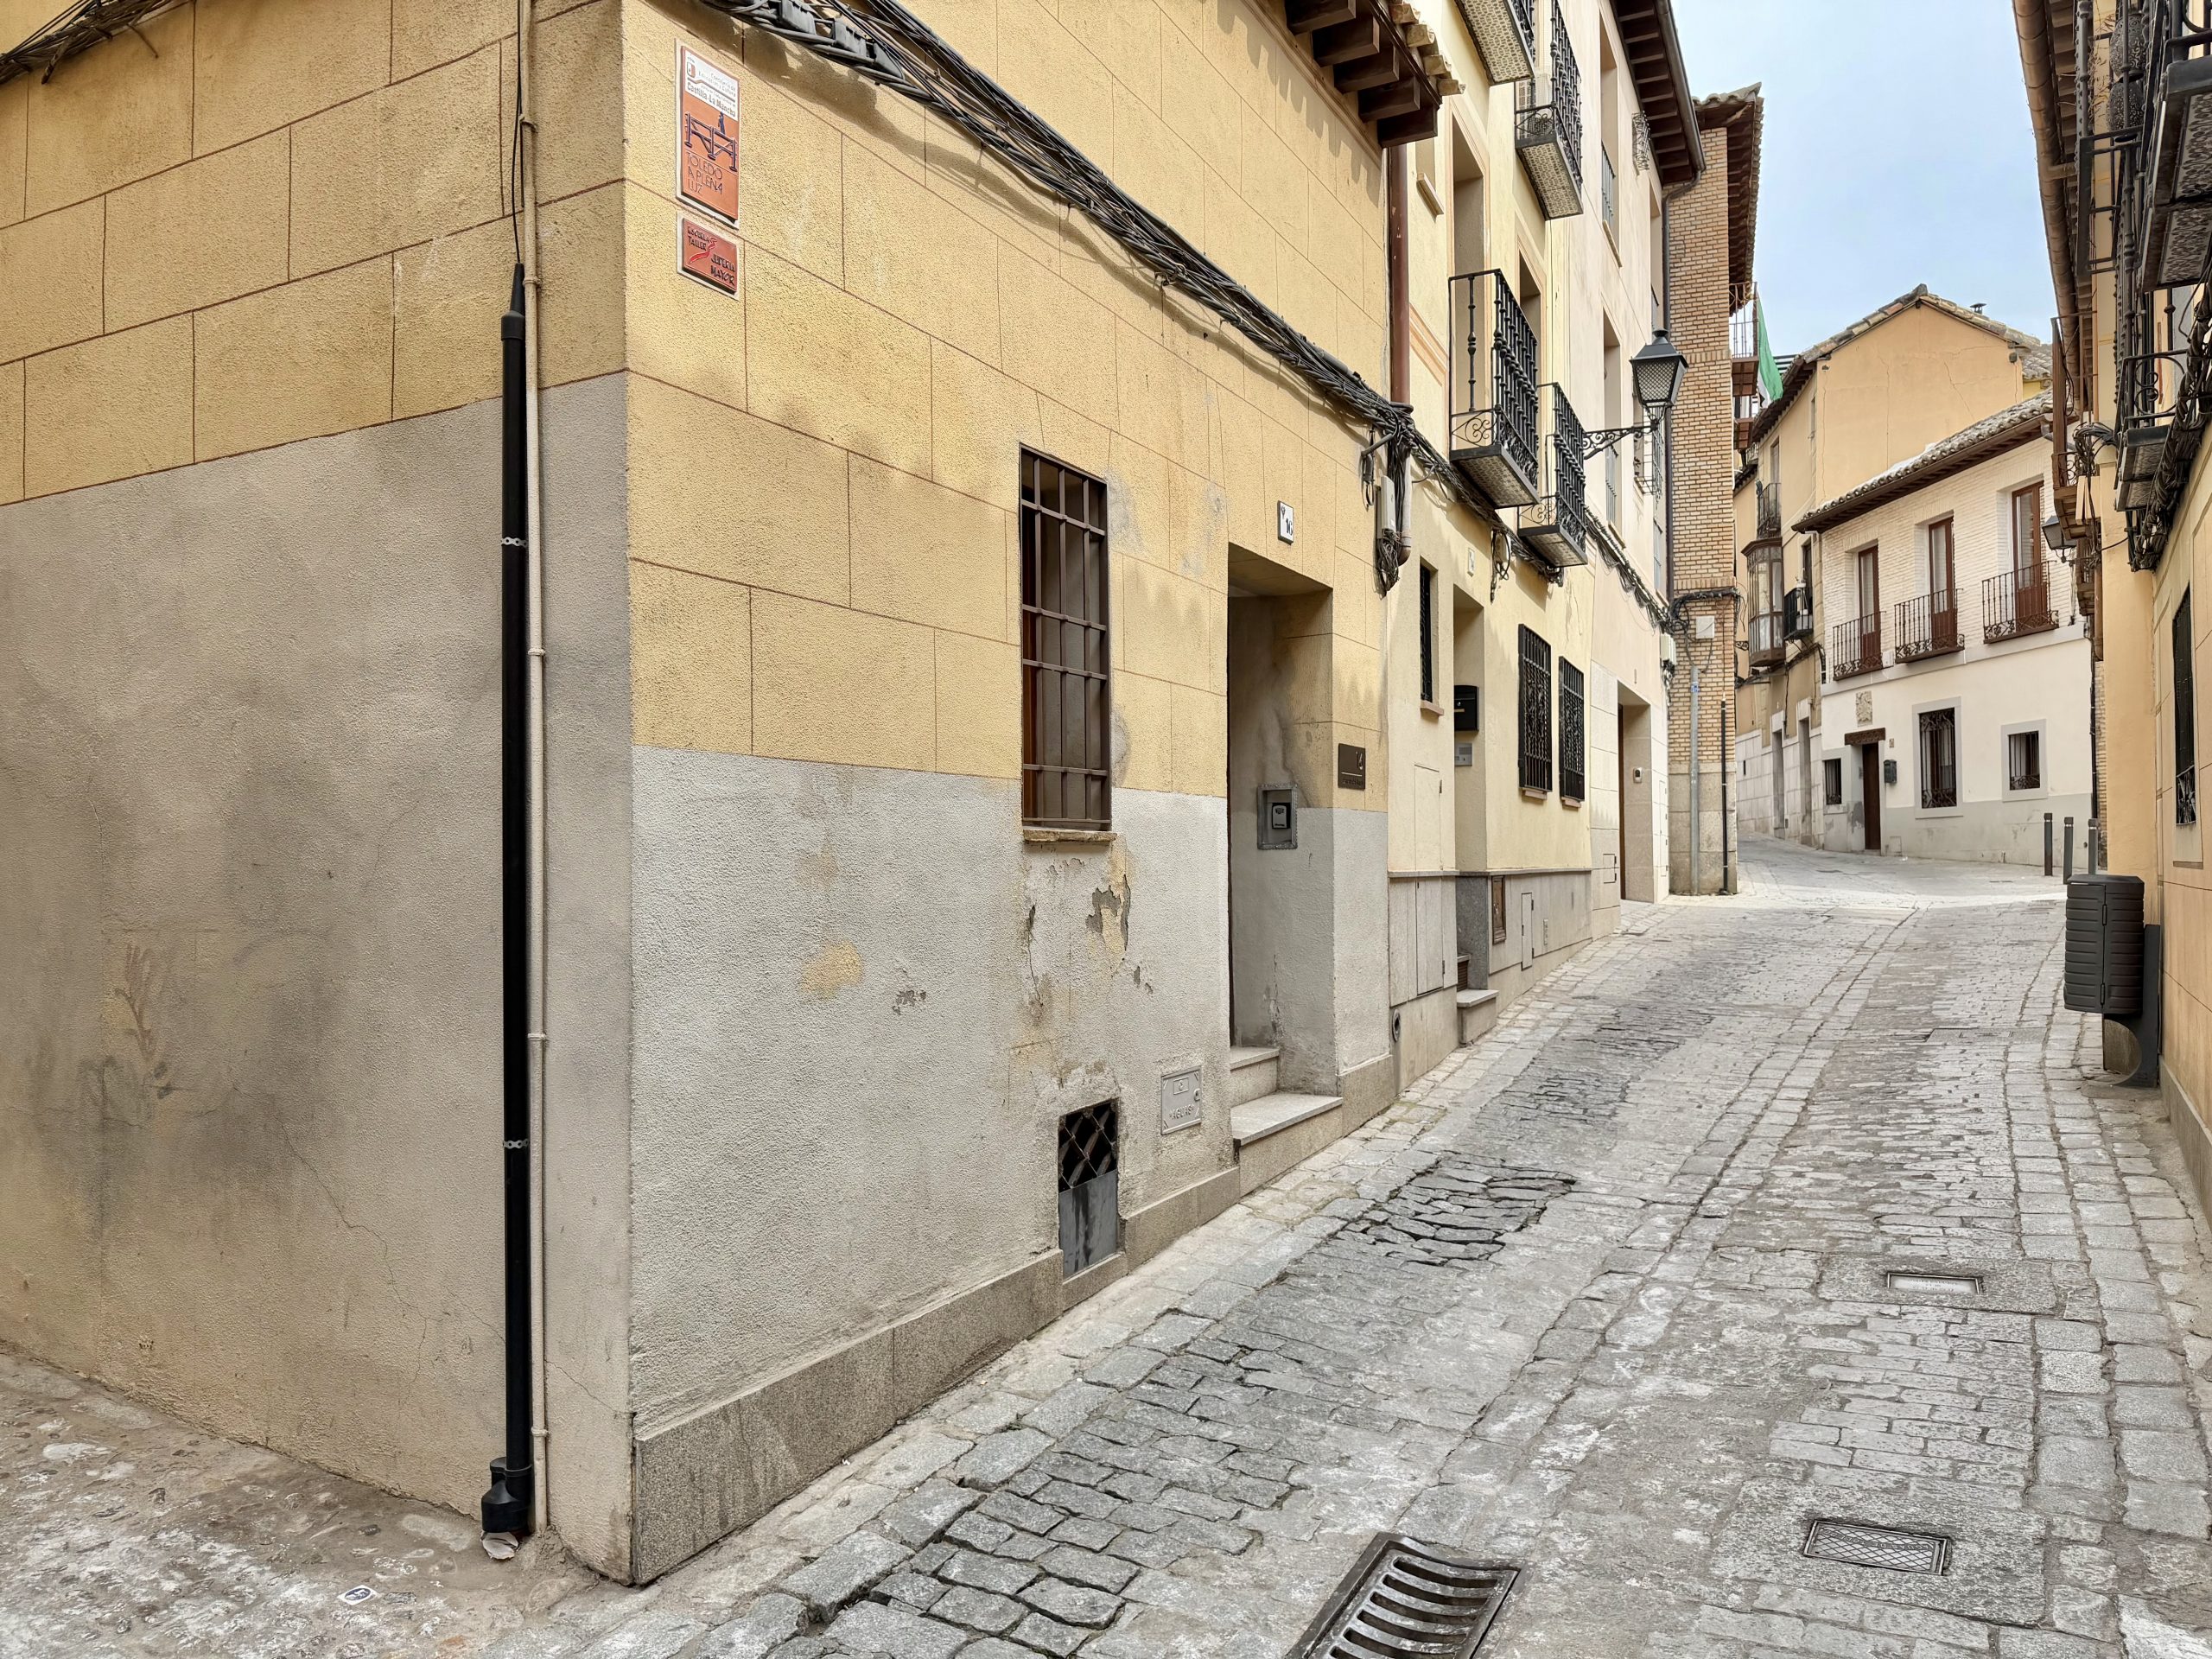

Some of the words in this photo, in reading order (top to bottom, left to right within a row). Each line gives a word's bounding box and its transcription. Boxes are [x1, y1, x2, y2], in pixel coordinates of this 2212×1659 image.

[716, 99, 736, 118] Mancha
[686, 151, 723, 181] TOLEDO
[688, 165, 695, 181] A
[696, 169, 723, 195] PLENA
[688, 178, 702, 194] LUZ
[687, 226, 709, 243] ESCUELA
[688, 235, 707, 251] TALLER
[710, 264, 735, 287] MAYOR
[1286, 518, 1294, 537] 16
